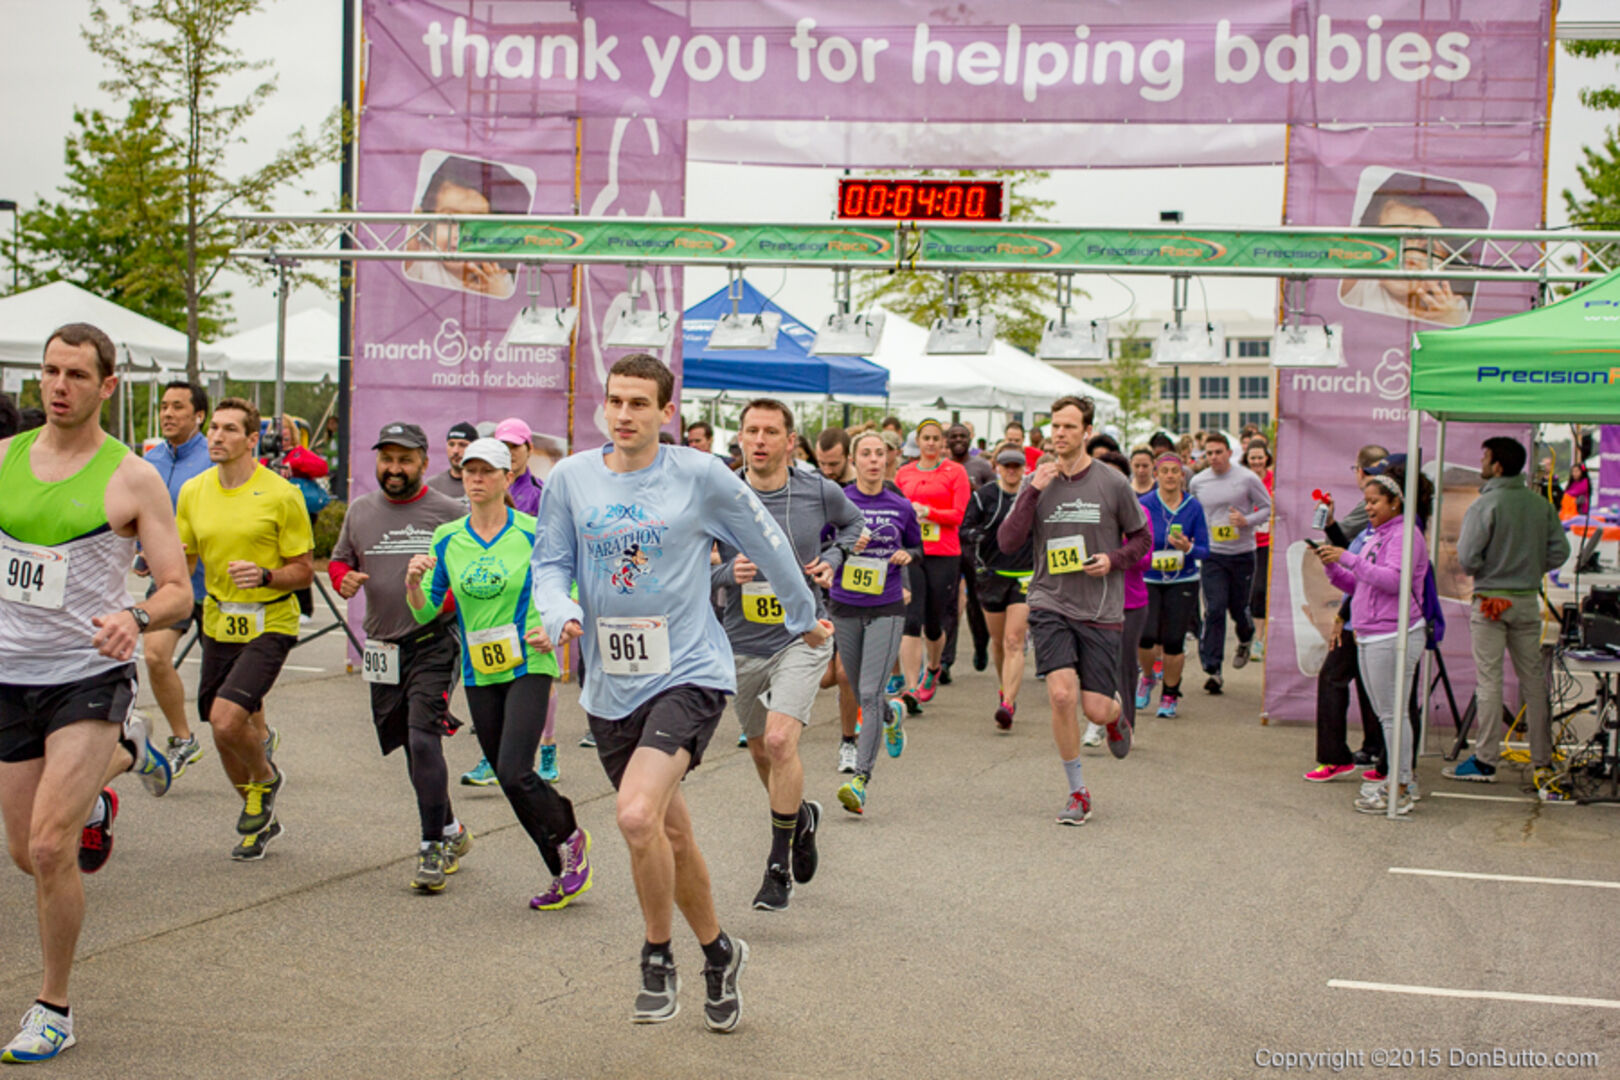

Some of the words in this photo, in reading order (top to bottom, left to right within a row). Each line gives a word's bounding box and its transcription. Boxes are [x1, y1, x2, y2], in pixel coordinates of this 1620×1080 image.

[422, 17, 621, 81] thank
[642, 35, 767, 98] you
[790, 17, 889, 83] for
[912, 22, 1185, 101] helping
[1215, 14, 1471, 83] babies
[844, 185, 986, 217] 00:04:00
[463, 235, 563, 247] PrecisionRace
[607, 237, 714, 249] PrecisionRace
[759, 240, 868, 252] PrecisionRace
[926, 242, 1038, 254] PrecisionRace
[1087, 245, 1202, 257] PrecisionRace
[1253, 247, 1372, 260] PrecisionRace
[363, 339, 431, 360] march
[469, 341, 491, 361] of
[494, 342, 556, 363] dimes
[432, 370, 479, 386] march
[484, 371, 505, 387] for
[1292, 370, 1371, 393] march
[1218, 526, 1231, 538] 42
[587, 527, 661, 558] MARATHON
[1051, 549, 1079, 568] 134
[7, 558, 44, 591] 904
[853, 569, 873, 587] 95
[757, 597, 782, 617] 85
[226, 616, 249, 636] 38
[481, 643, 506, 667] 68
[609, 633, 648, 661] 961
[365, 651, 388, 673] 903
